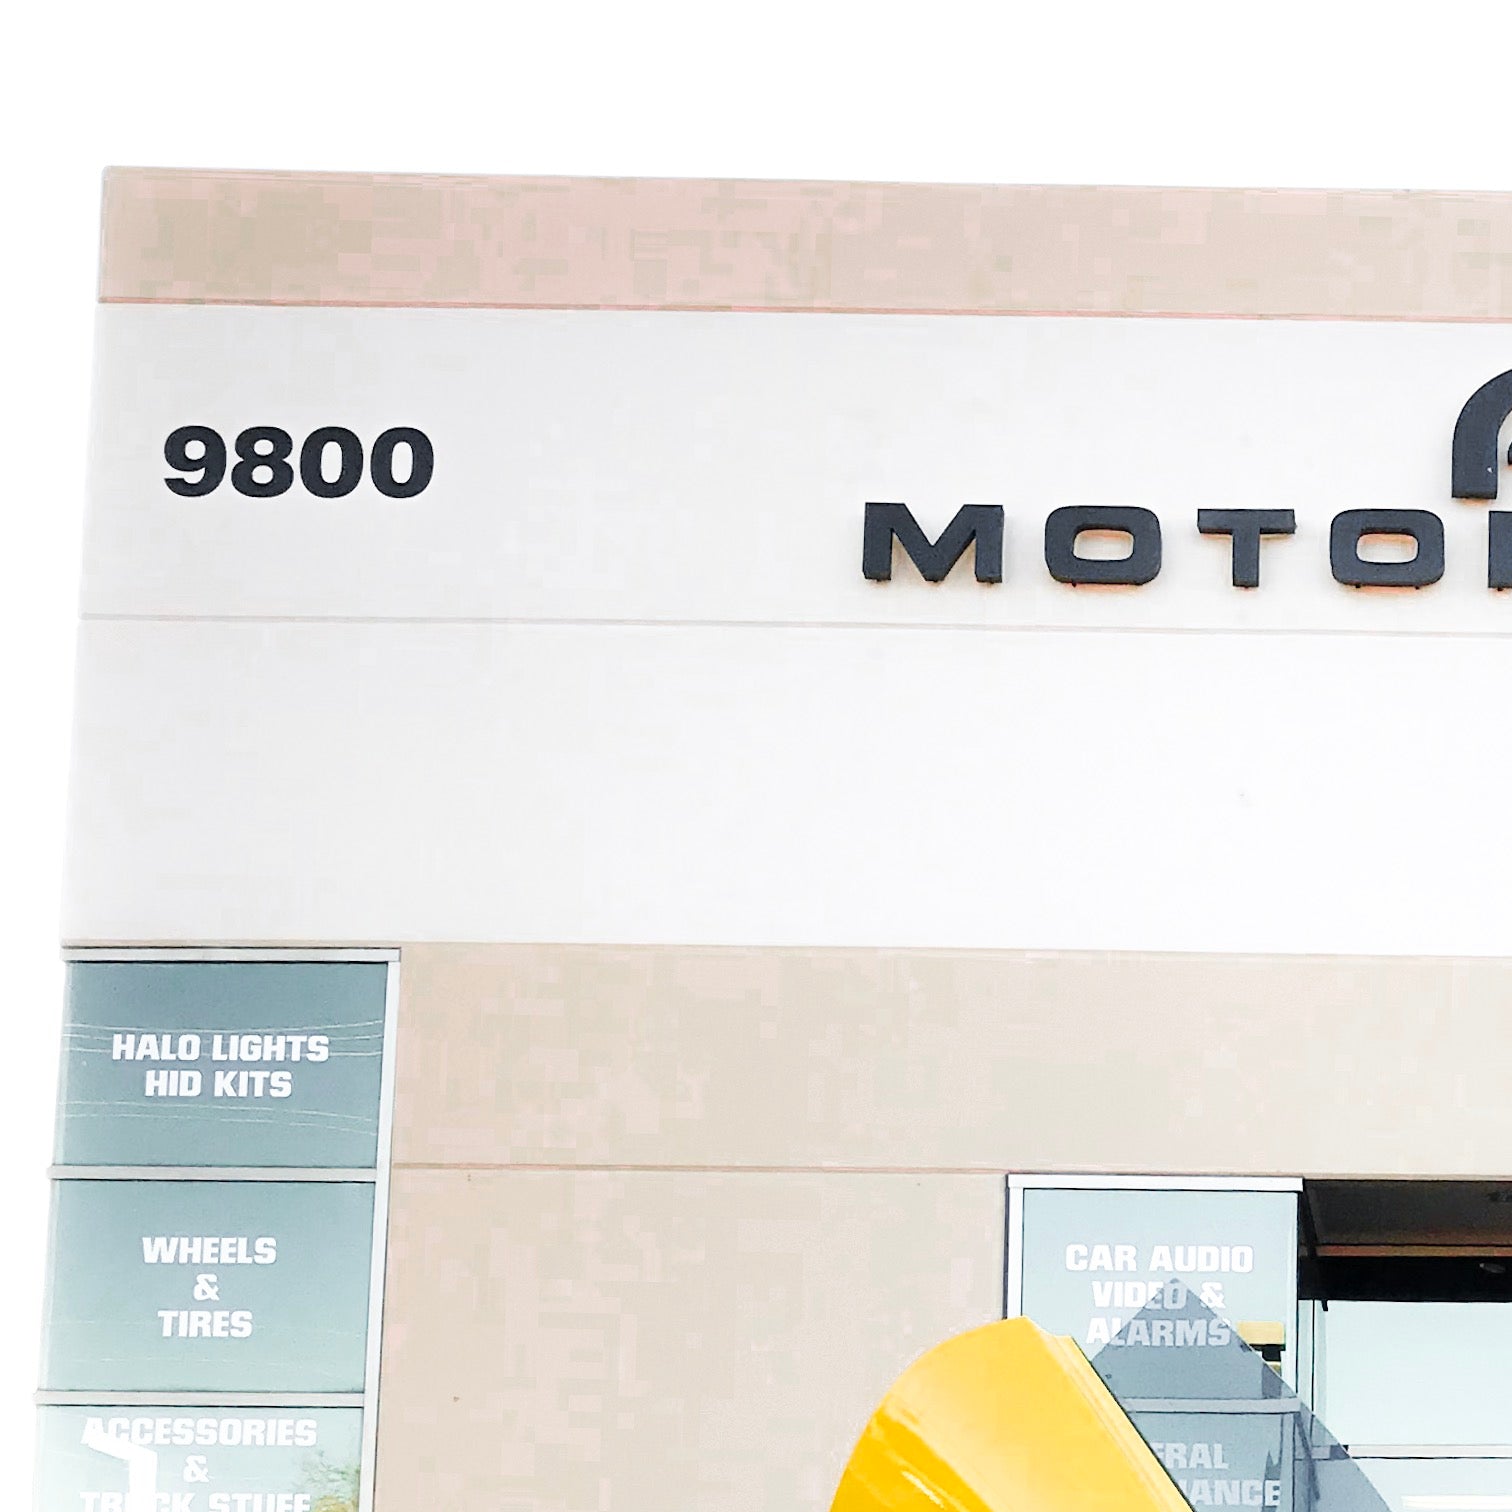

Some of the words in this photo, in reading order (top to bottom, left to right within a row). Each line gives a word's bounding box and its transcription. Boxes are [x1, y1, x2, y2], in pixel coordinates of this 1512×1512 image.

[163, 425, 434, 499] 9800
[112, 1033, 201, 1061] HALO
[212, 1034, 329, 1062] LIGHTS
[145, 1069, 202, 1097] HID
[213, 1070, 292, 1098] KITS
[142, 1236, 277, 1264] WHEELS
[1065, 1244, 1137, 1272] CAR
[1148, 1245, 1254, 1273] AUDIO
[193, 1273, 220, 1301] &
[1091, 1281, 1187, 1310] VIDEO
[1200, 1281, 1226, 1309] &
[157, 1310, 253, 1338] TIRES
[1086, 1317, 1232, 1347] ALARMS
[80, 1417, 317, 1446] ACCESSORIES
[183, 1455, 210, 1483] &
